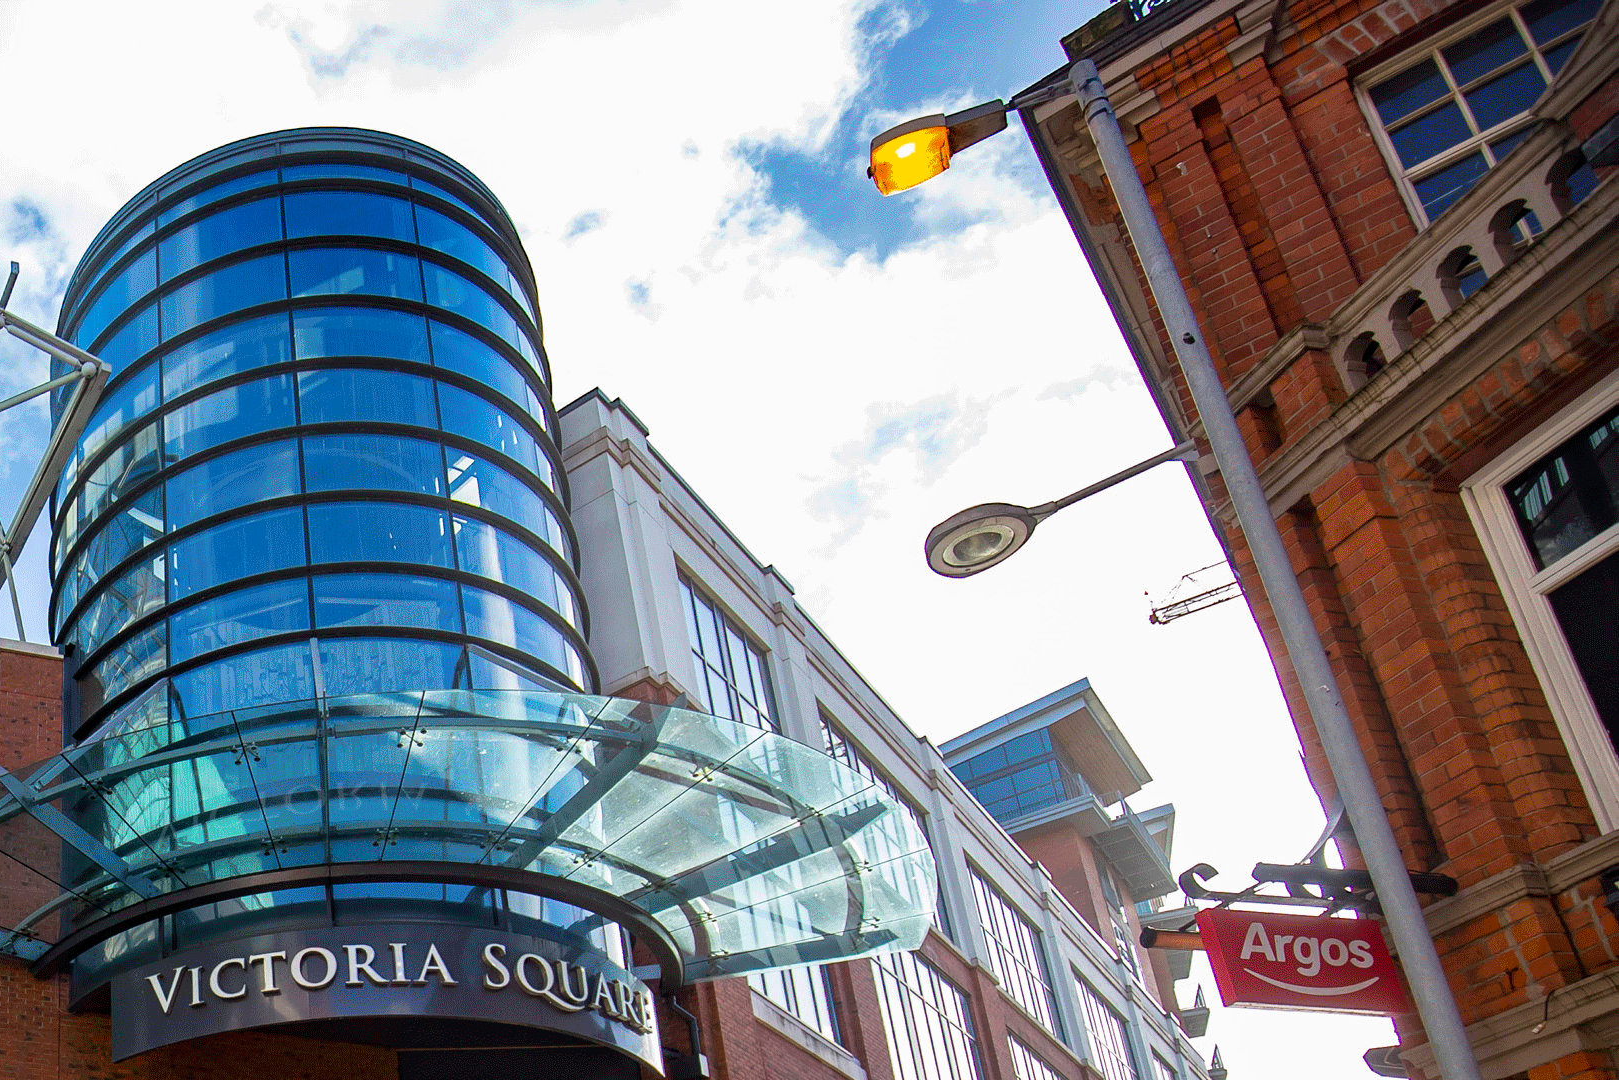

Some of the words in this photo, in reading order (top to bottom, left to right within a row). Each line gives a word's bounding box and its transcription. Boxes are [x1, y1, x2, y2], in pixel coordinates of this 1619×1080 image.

[1239, 922, 1375, 977] Argos
[144, 942, 458, 1015] VICTORIA
[482, 943, 656, 1034] SQUARE
